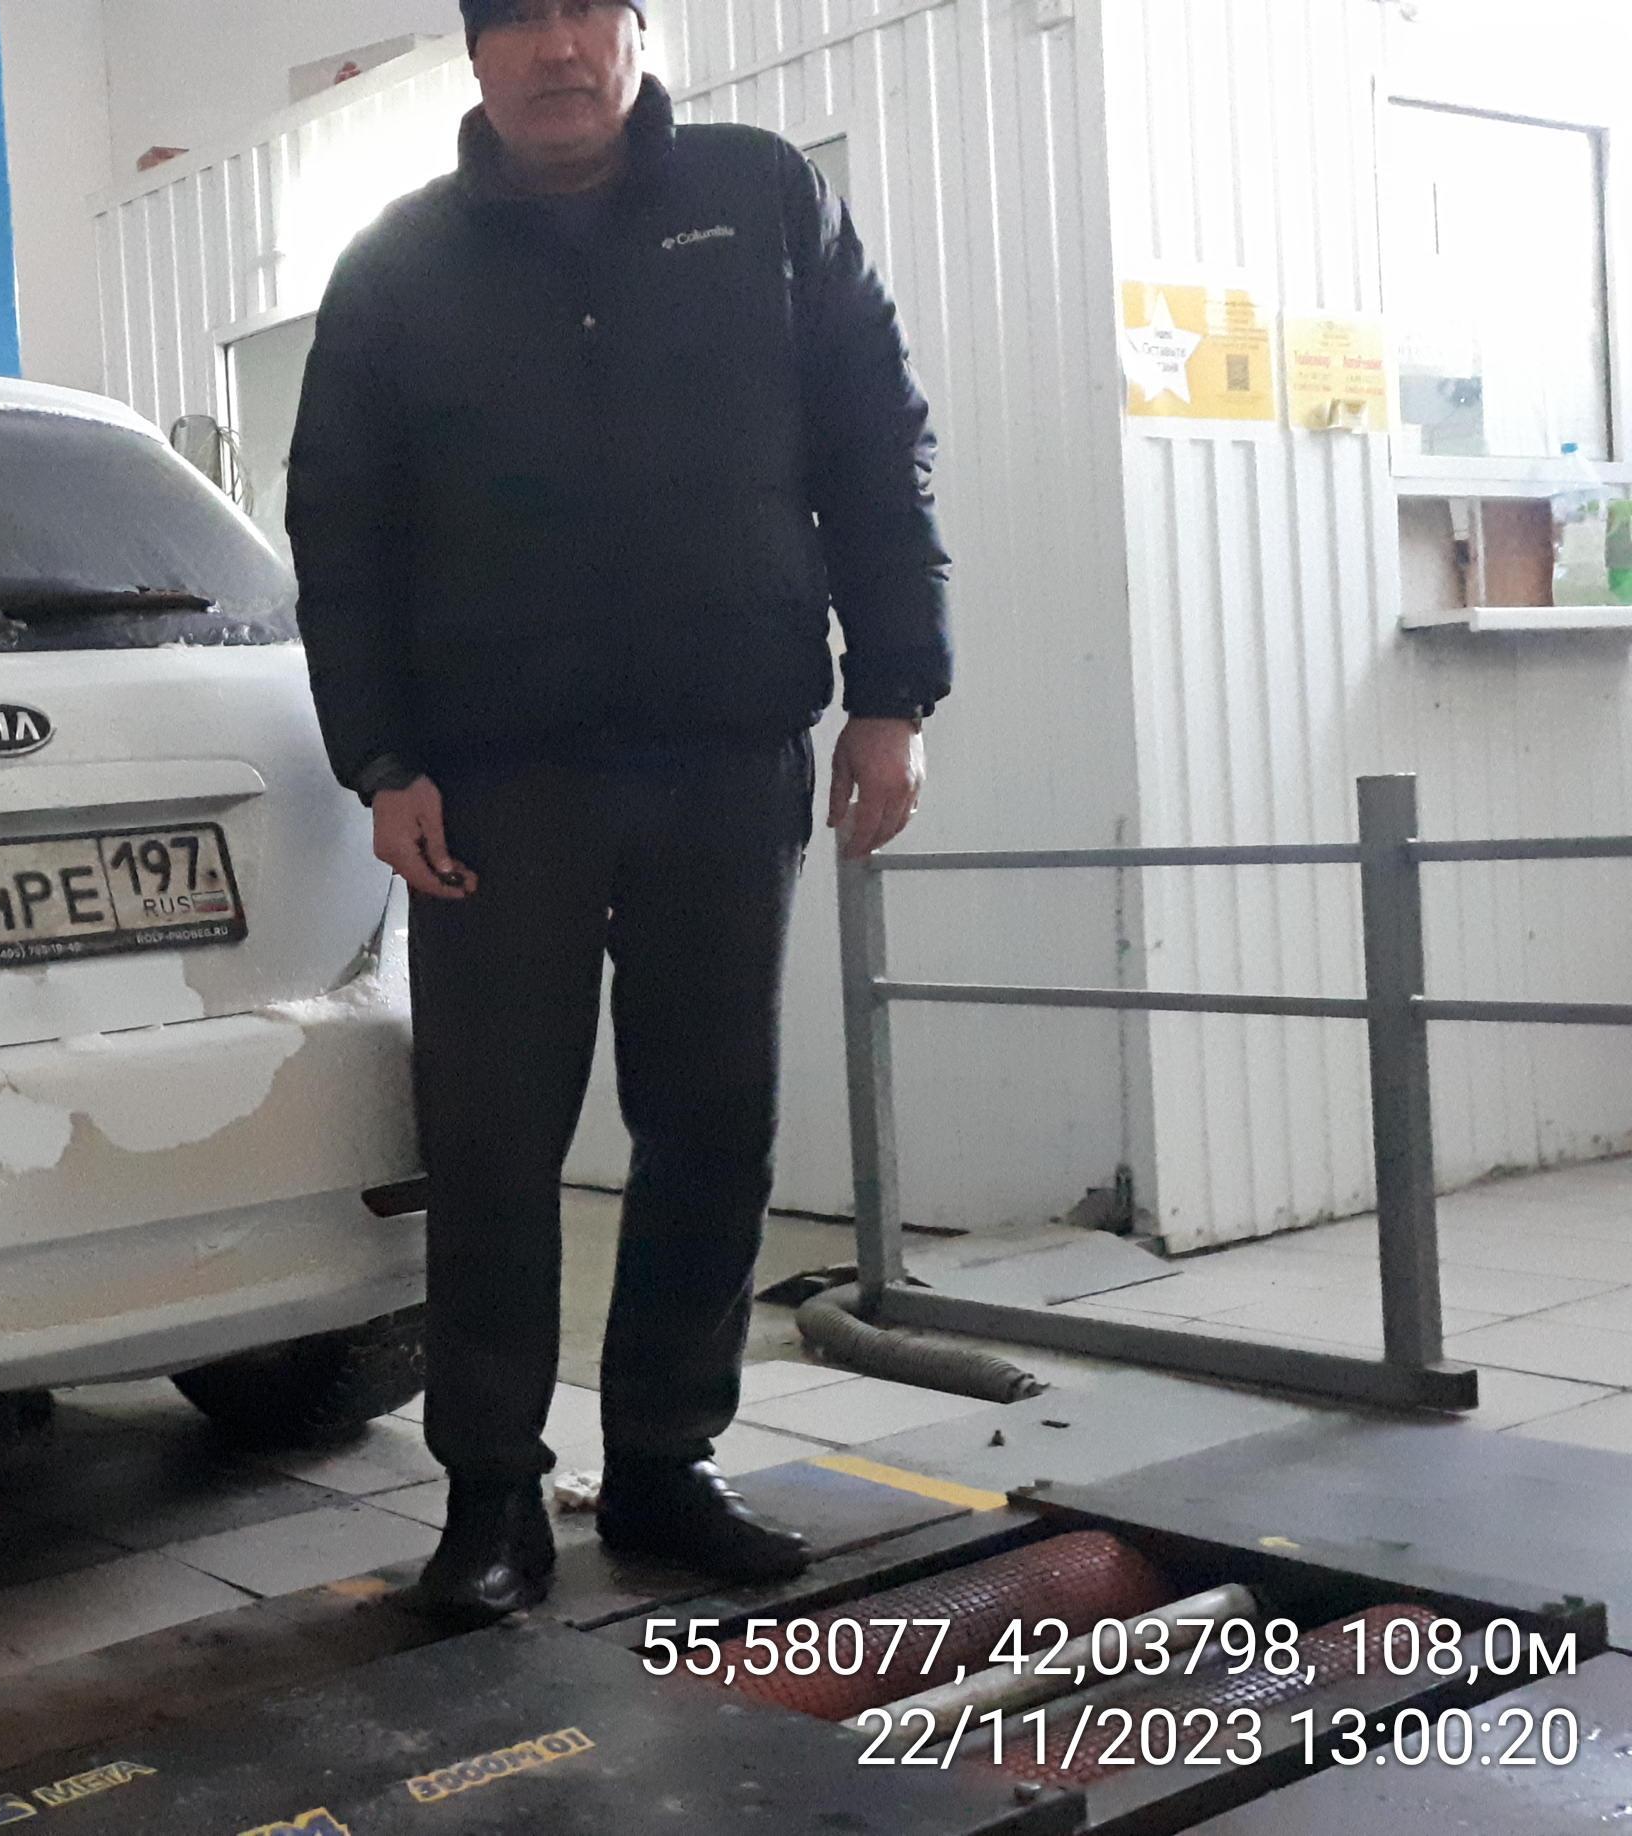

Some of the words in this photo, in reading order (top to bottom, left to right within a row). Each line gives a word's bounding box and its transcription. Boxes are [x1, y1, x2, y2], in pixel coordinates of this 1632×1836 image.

[676, 224, 735, 245] Columbia
[112, 836, 200, 895] 197
[143, 896, 192, 918] RUS
